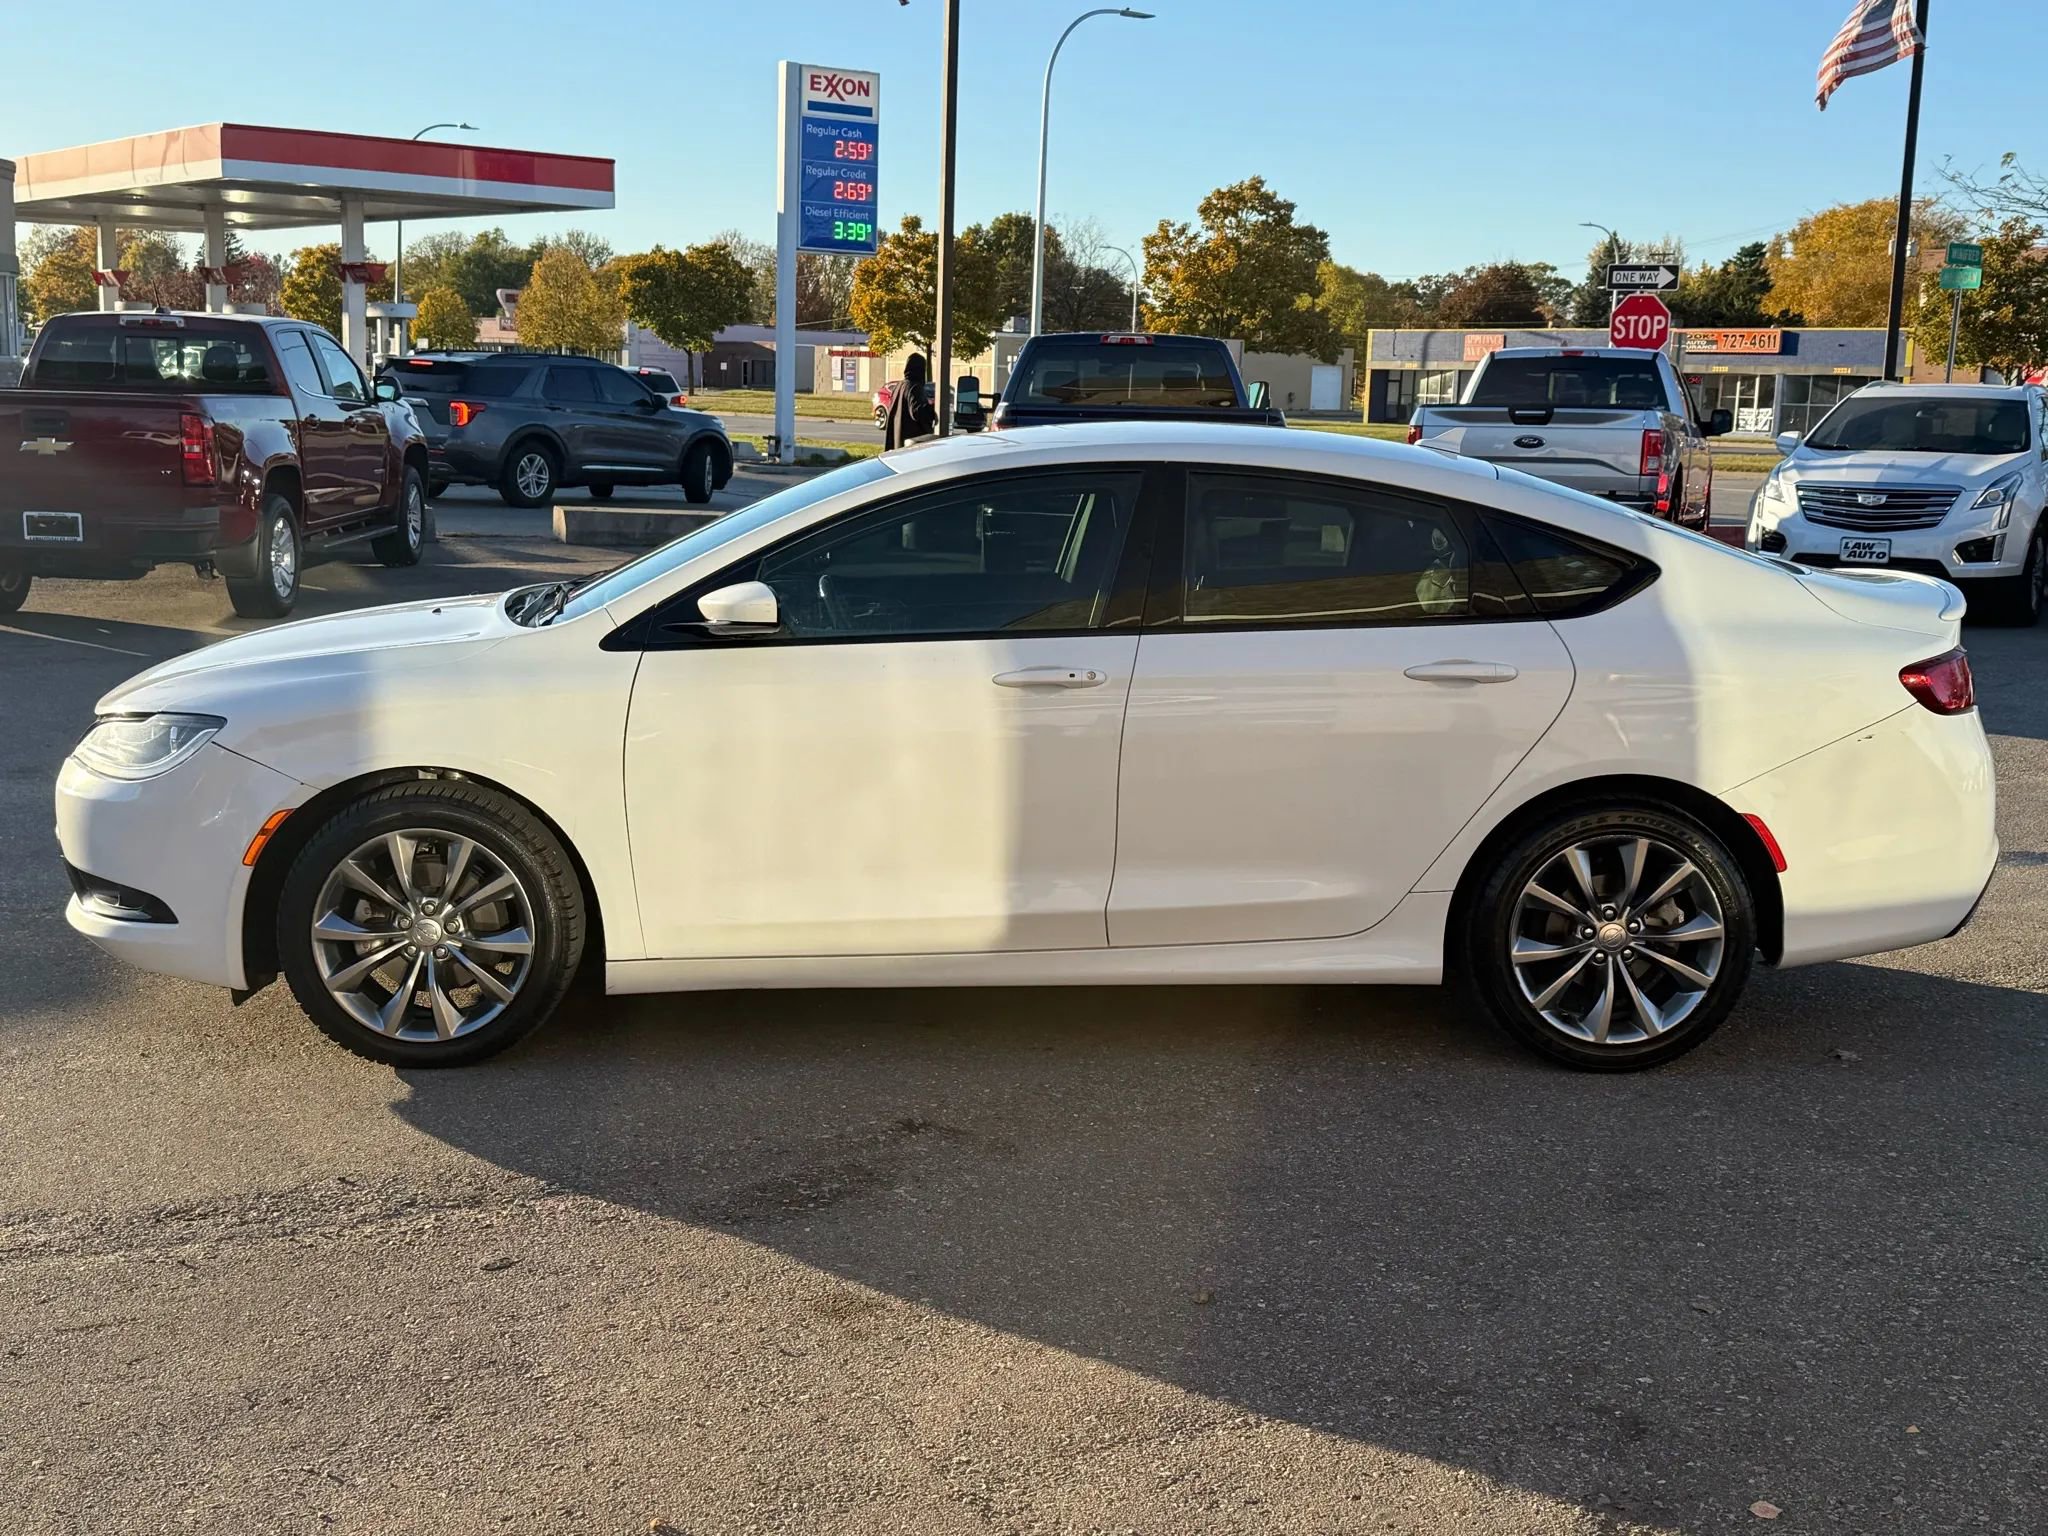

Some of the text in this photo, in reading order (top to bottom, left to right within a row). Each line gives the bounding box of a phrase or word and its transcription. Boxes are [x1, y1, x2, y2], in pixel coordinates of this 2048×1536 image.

[809, 73, 870, 101] EXXON
[806, 124, 862, 139] Regular Cash
[806, 165, 866, 179] Regular Credit
[805, 206, 869, 220] Diesel Efficient
[1614, 272, 1660, 282] ONE WAY
[1613, 315, 1666, 340] STOP
[1722, 333, 1777, 349] 727-4611
[1843, 541, 1876, 551] LAW
[1846, 550, 1887, 560] AUTO
